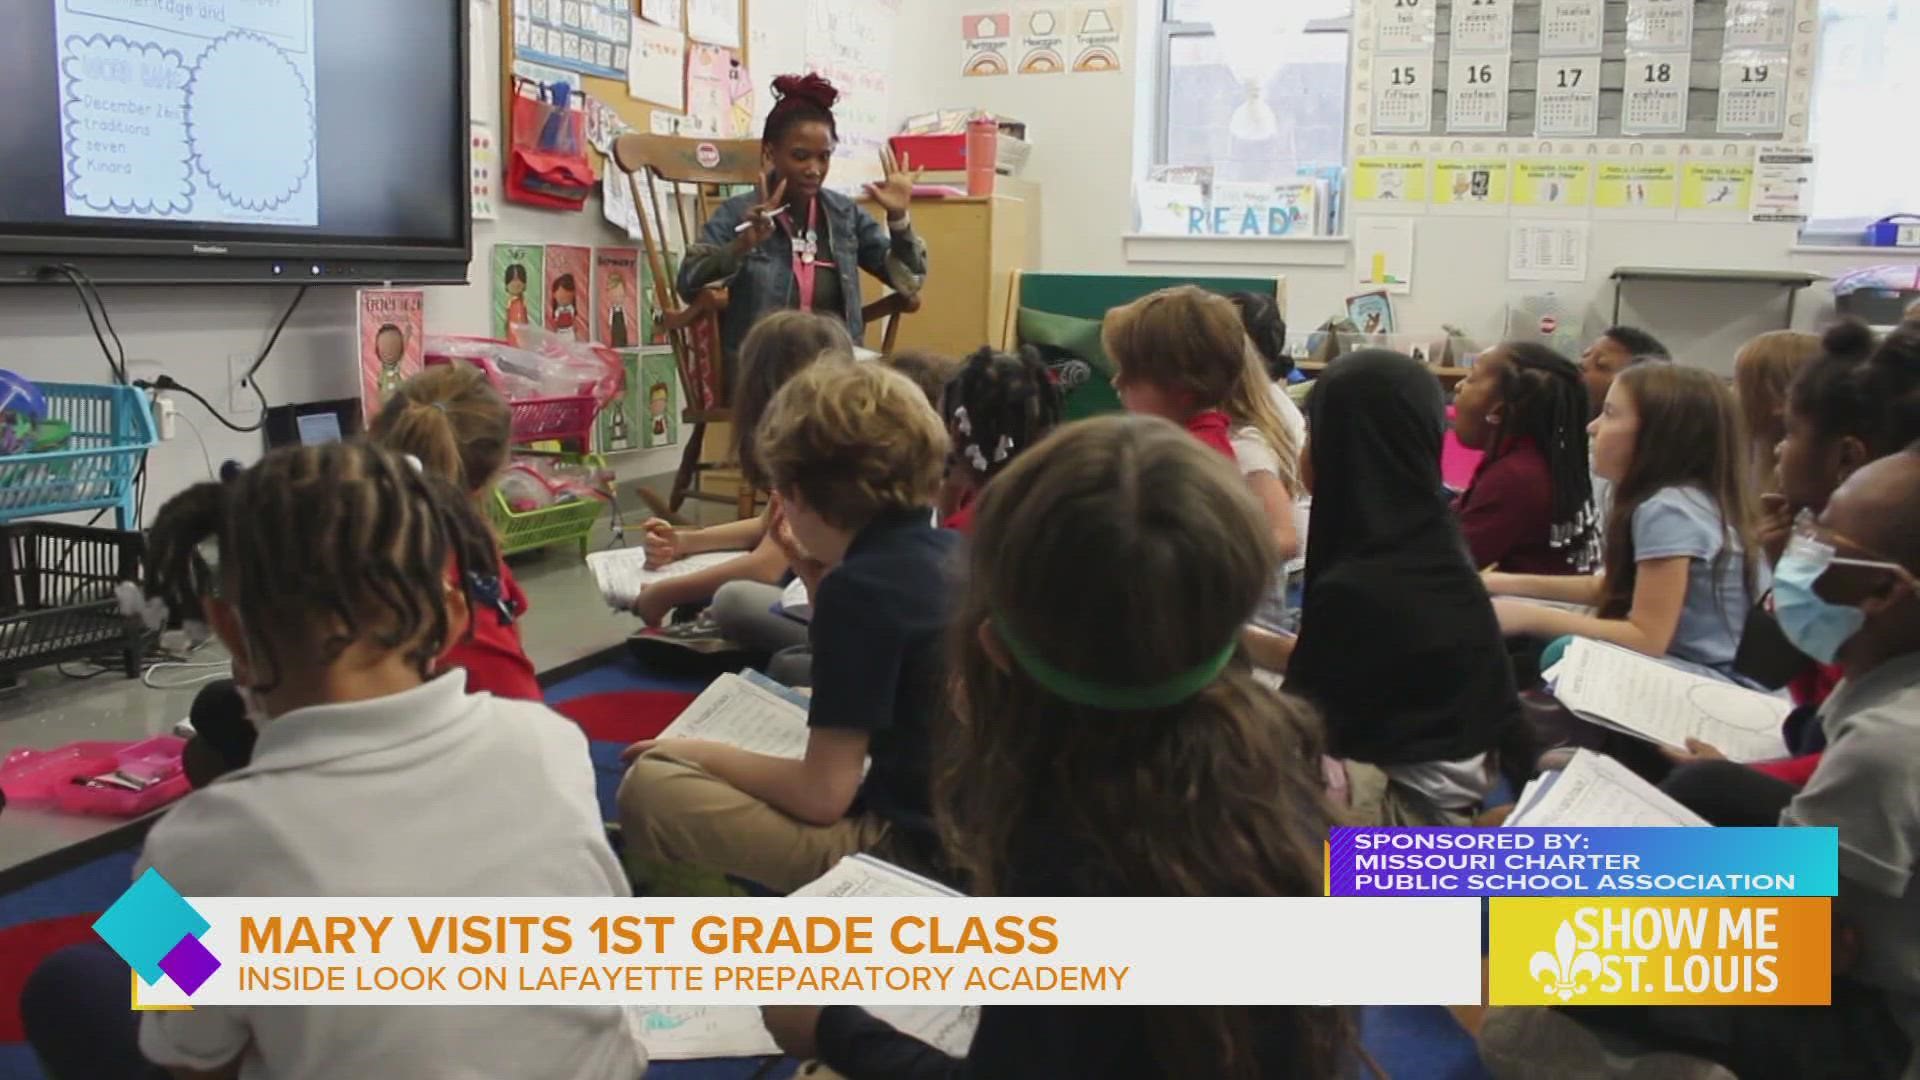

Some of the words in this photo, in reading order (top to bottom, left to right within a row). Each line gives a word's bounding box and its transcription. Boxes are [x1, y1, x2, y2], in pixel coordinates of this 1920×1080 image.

[1391, 66, 1416, 85] 15
[1467, 65, 1492, 84] 16
[1556, 68, 1582, 88] 17
[1644, 63, 1672, 83] 18
[1741, 65, 1769, 83] 19
[84, 94, 151, 116] December
[1633, 90, 1679, 101] eighteen
[84, 118, 151, 137] traditions
[1187, 206, 1292, 235] READ
